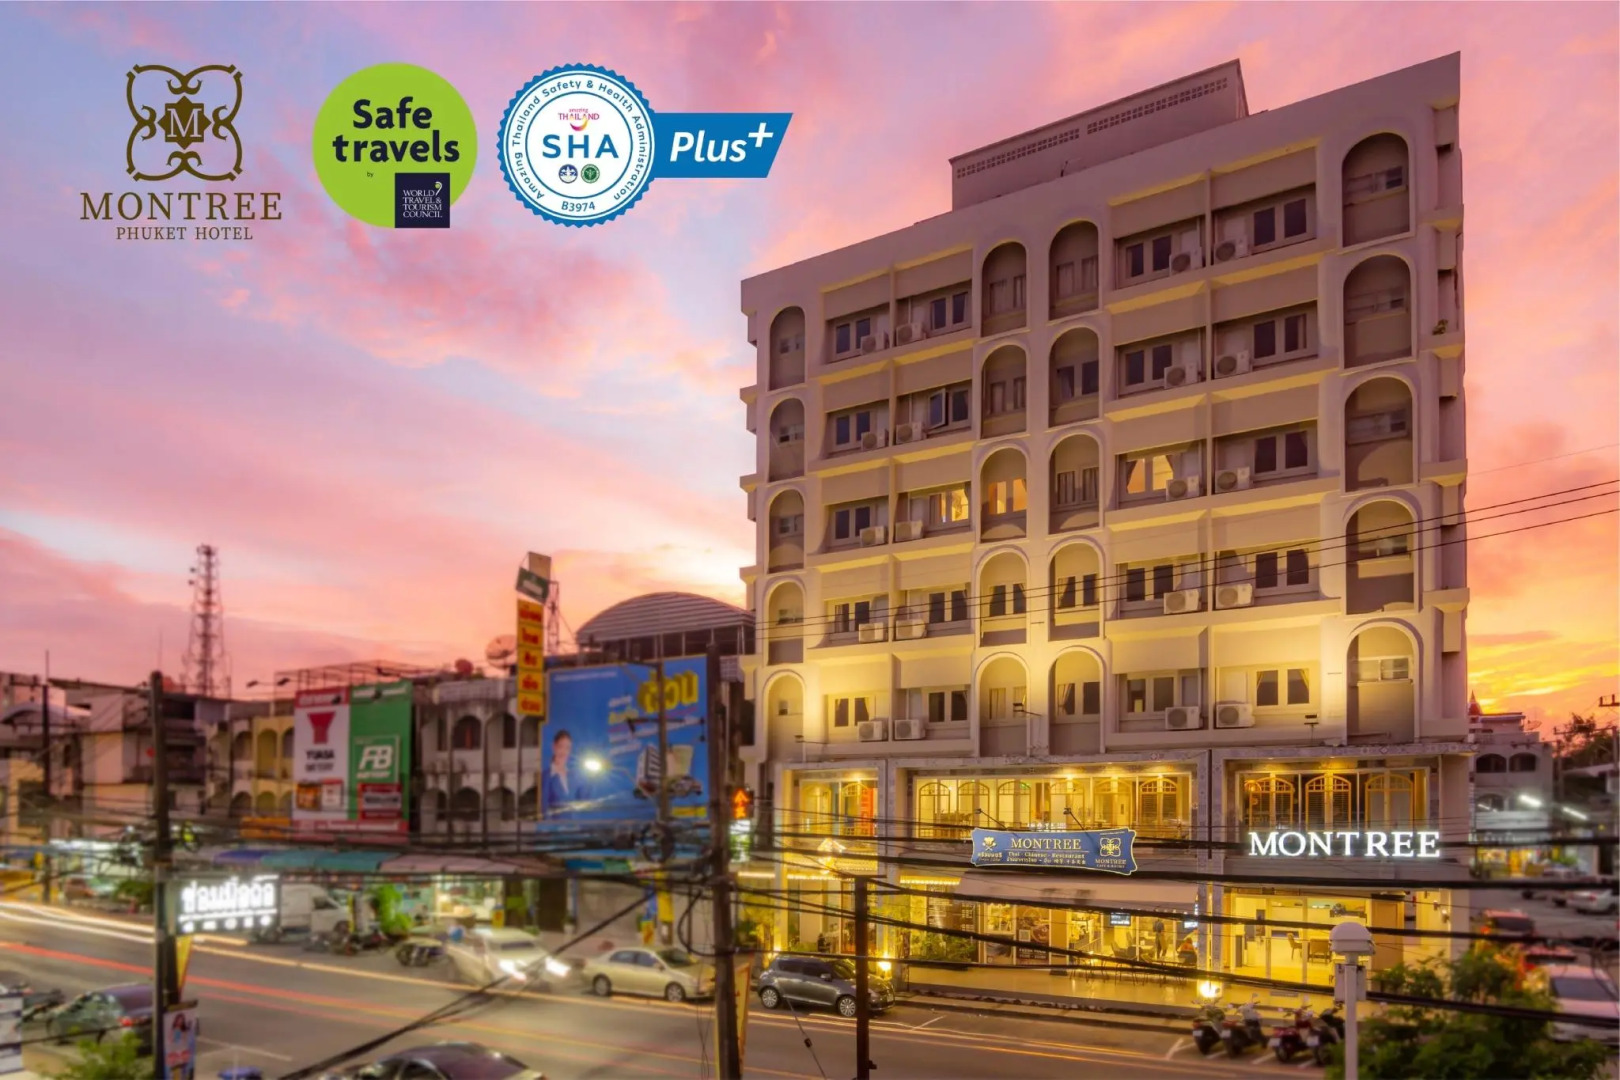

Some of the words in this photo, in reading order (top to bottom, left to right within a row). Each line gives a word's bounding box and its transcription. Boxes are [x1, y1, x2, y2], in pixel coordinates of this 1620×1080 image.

[359, 746, 393, 770] FB
[1011, 838, 1082, 850] MONTREE
[1248, 831, 1440, 857] MONTREE
